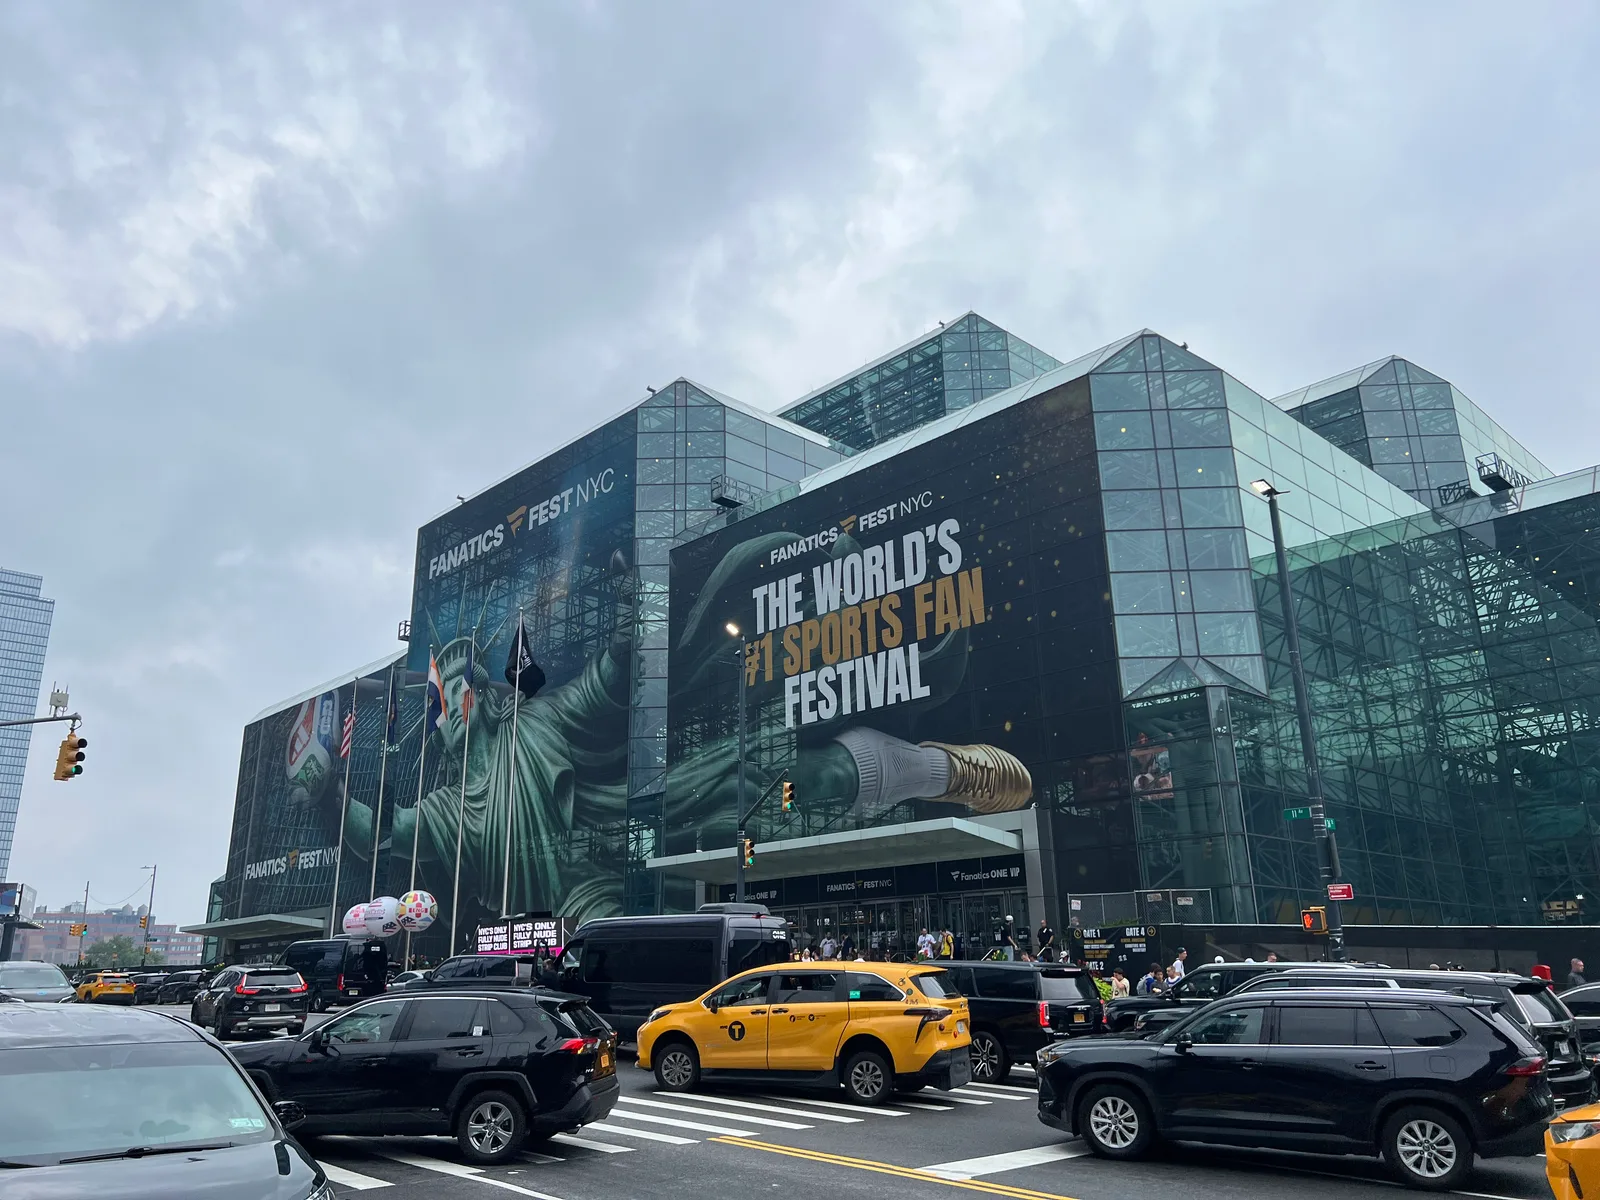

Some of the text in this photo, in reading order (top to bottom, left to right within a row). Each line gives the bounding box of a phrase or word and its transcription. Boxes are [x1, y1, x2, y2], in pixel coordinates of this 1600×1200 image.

[428, 467, 615, 580] FANATICS FEST NYC
[770, 490, 934, 565] FANATICS FEST NYC
[752, 518, 962, 635] THE WORLD'S
[744, 566, 986, 688] #1 SPORTS FAN
[784, 642, 930, 729] FESTIVAL
[245, 857, 287, 880] FANATICS
[298, 848, 323, 870] FEST
[960, 867, 1020, 881] Fanatics ONE VIP
[827, 878, 892, 892] FANATICS FEST NYC
[756, 891, 768, 900] ONE
[478, 925, 508, 936] NYC'S ONLY
[513, 921, 556, 932] NYC'S ONLY
[1125, 927, 1145, 936] GATE 4
[478, 934, 508, 944] FULLY NUDE
[513, 930, 557, 940] FULLY NUDE
[1083, 929, 1101, 938] GATE 1
[477, 942, 508, 952] STRIP CLUB
[513, 940, 532, 949] STRIP
[1100, 961, 1104, 970] 2
[731, 1025, 742, 1039] T
